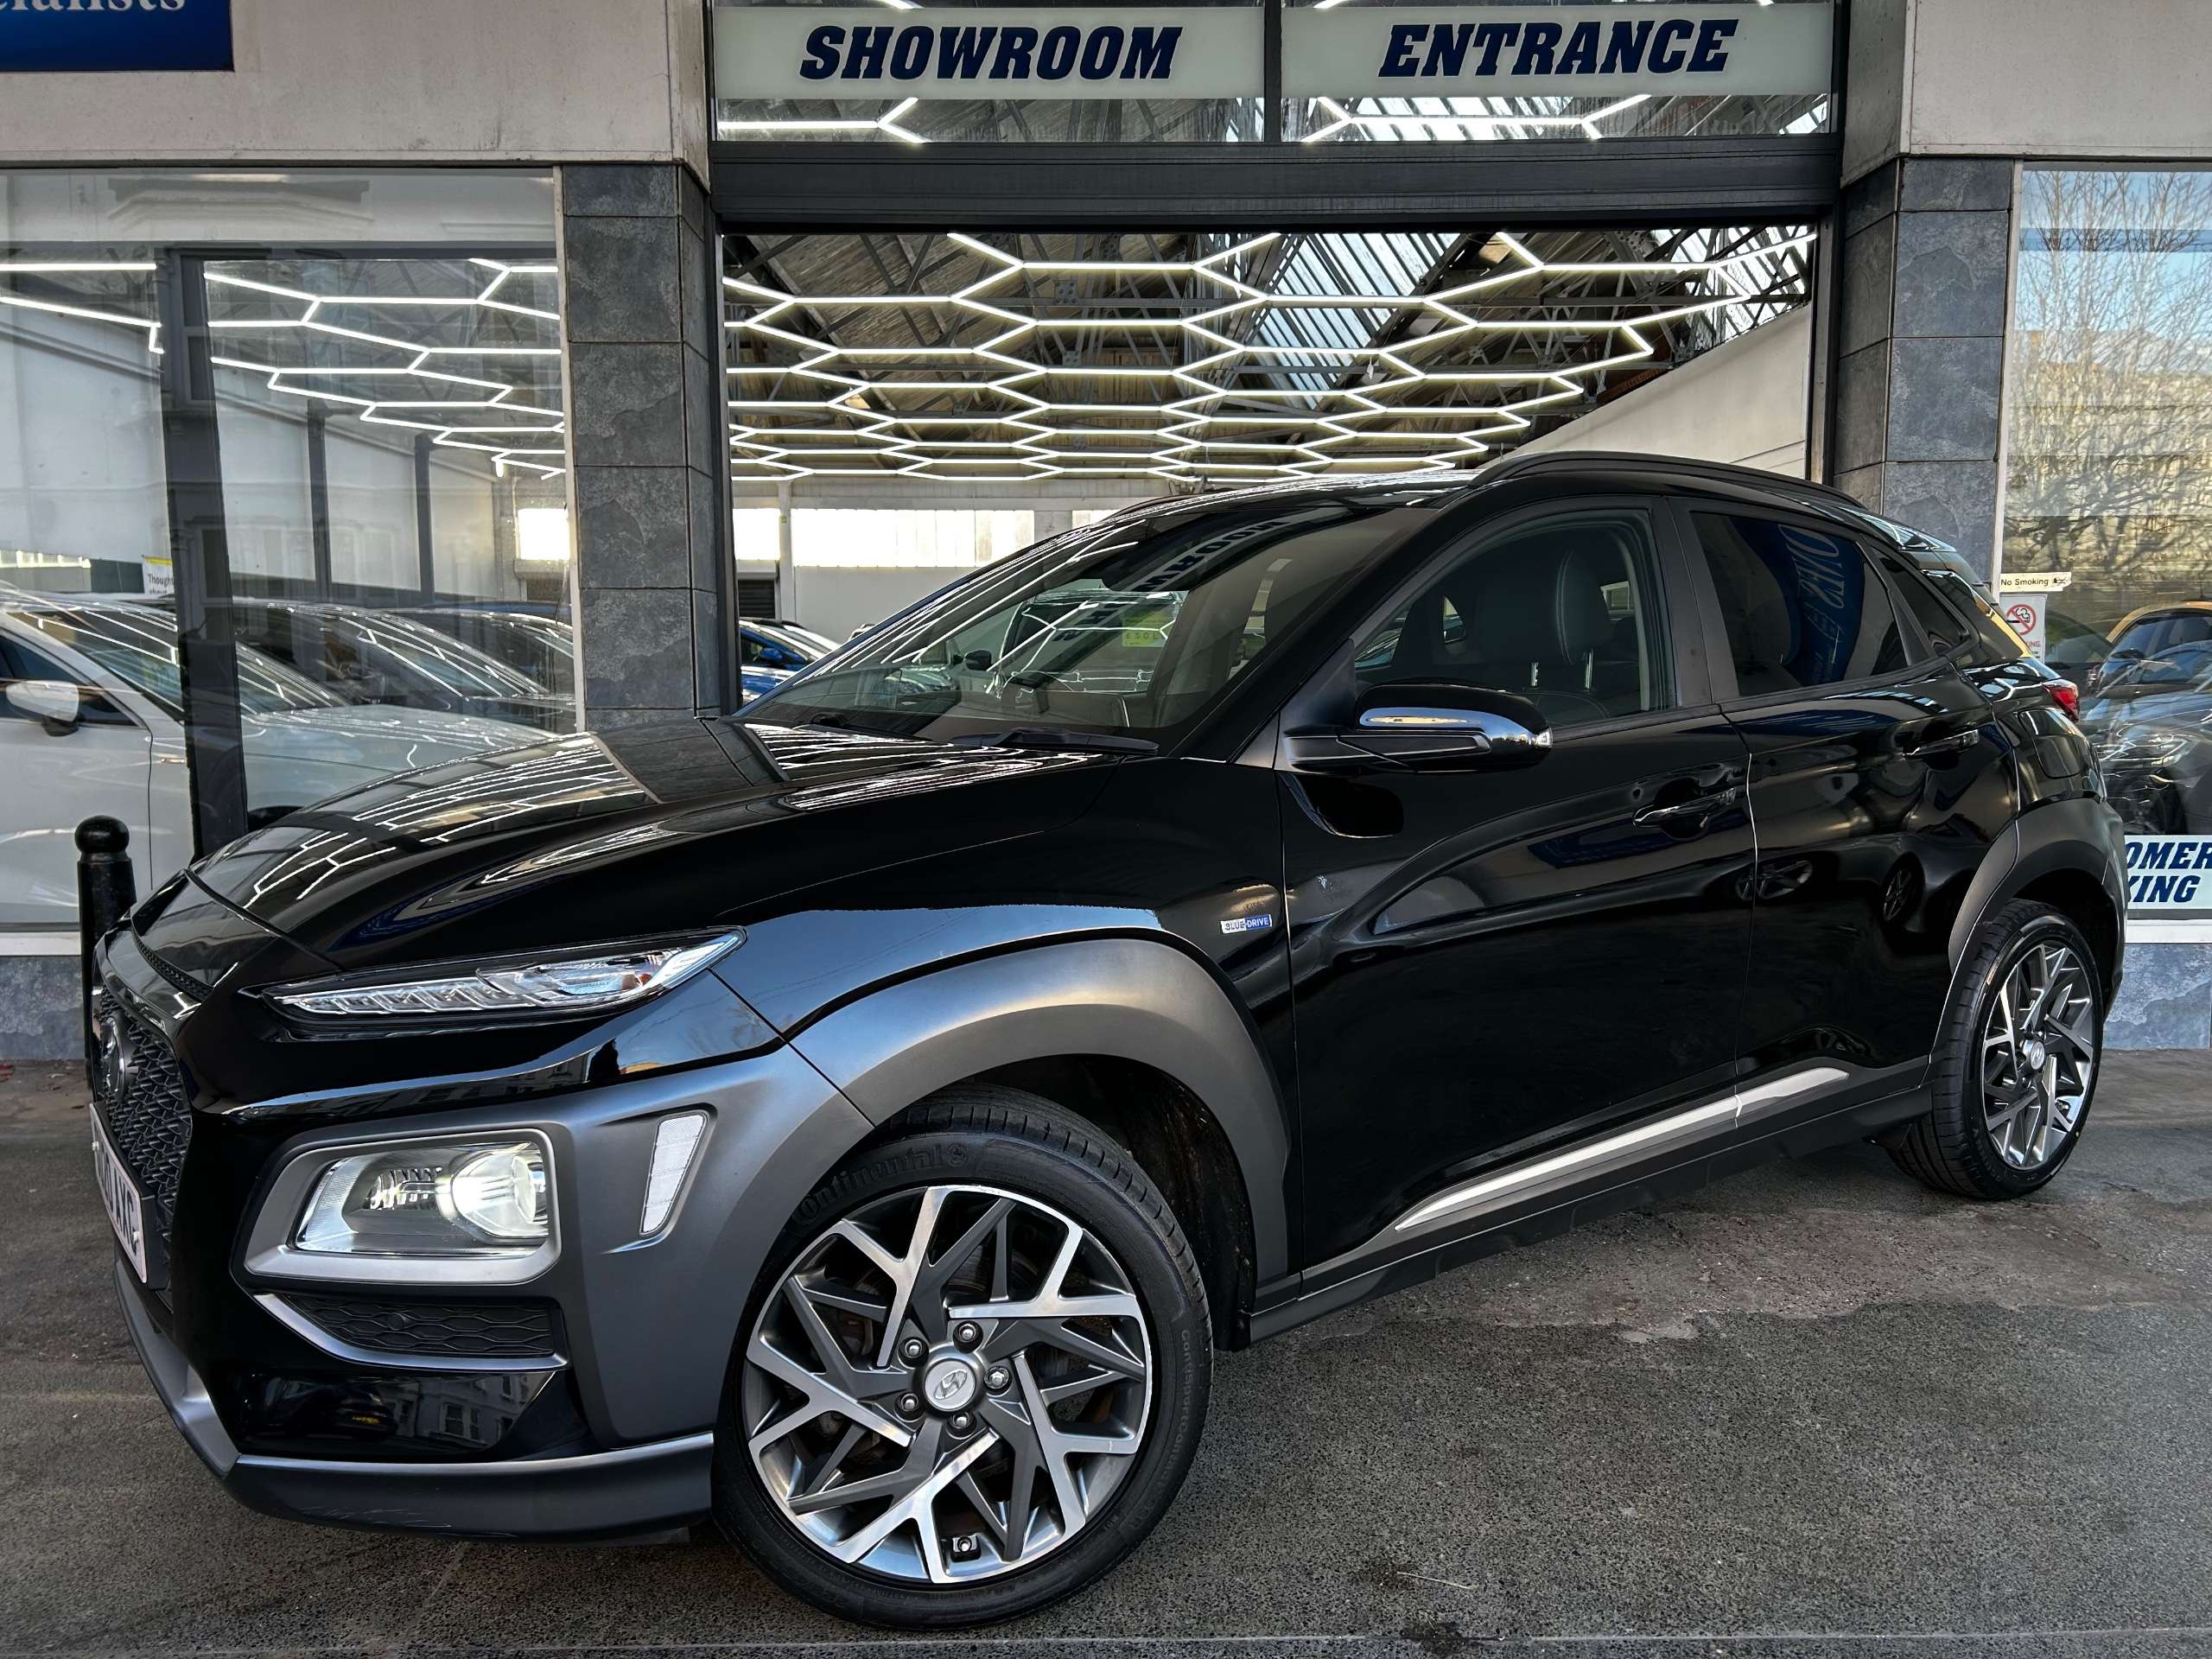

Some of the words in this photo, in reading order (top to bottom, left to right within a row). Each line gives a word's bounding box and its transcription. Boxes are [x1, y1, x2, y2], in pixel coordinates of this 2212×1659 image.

[800, 26, 1182, 80] SHOWROOM
[1378, 19, 1738, 78] ENTRANCE
[2014, 578, 2049, 588] Smoking
